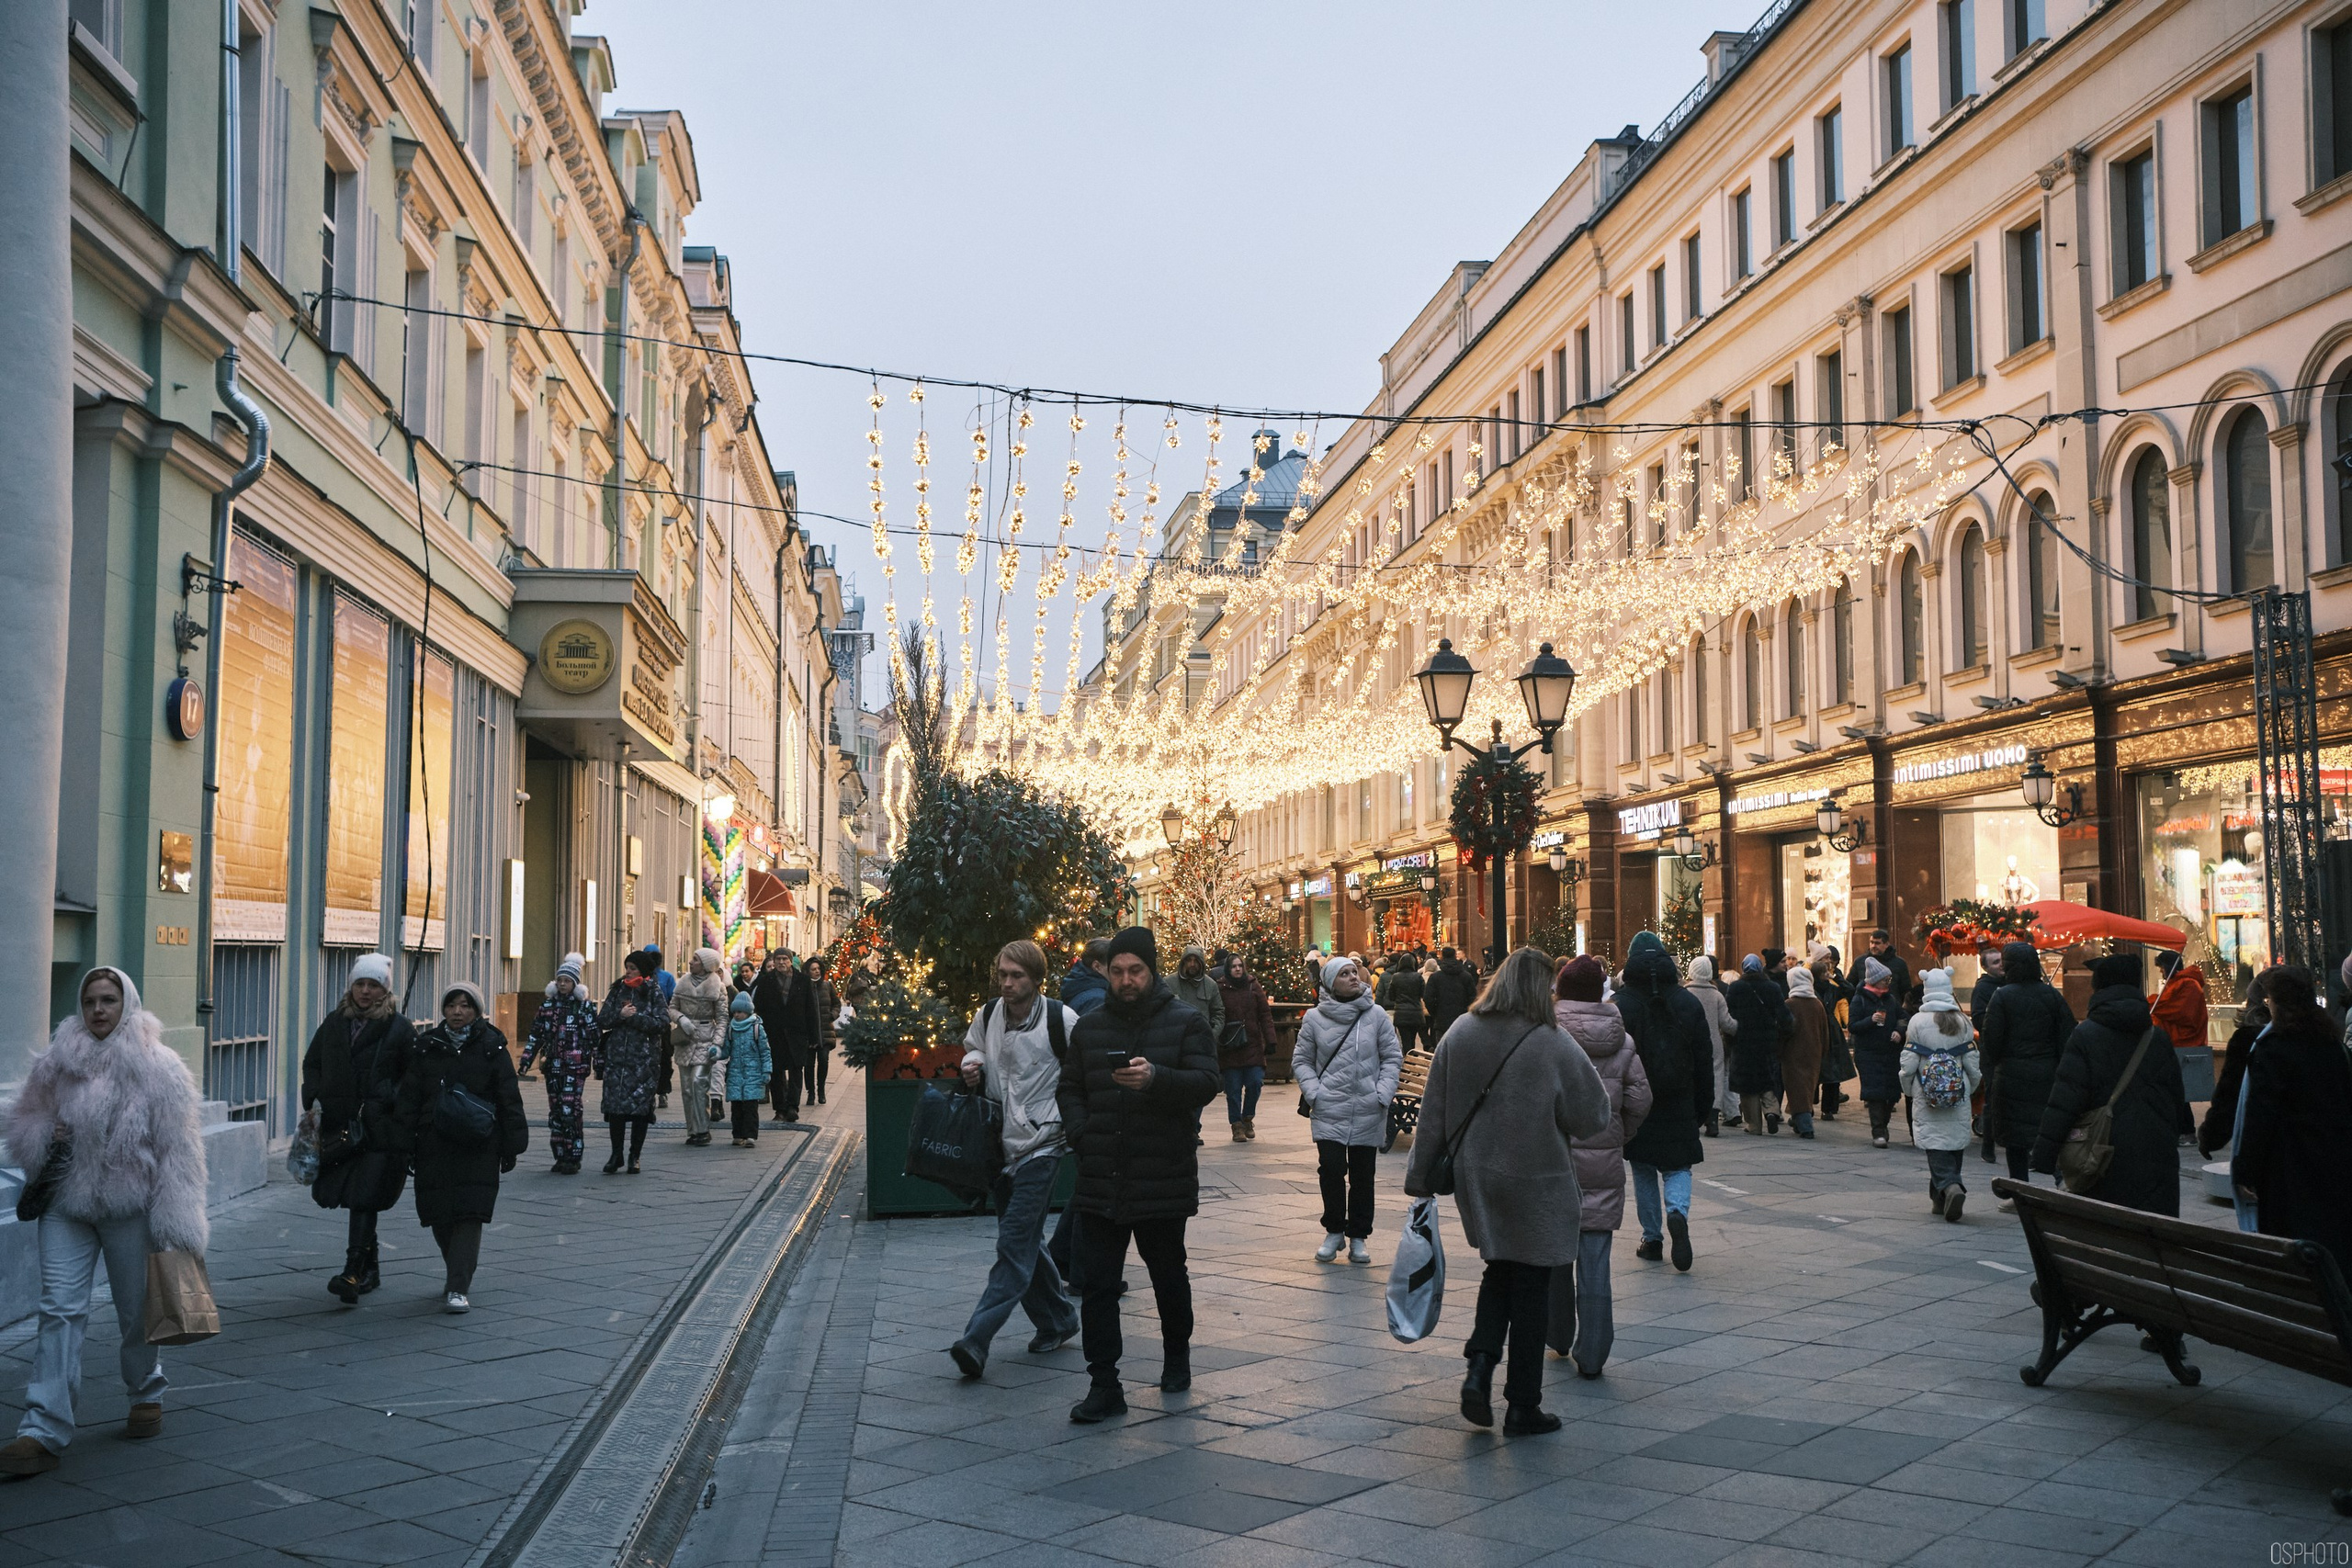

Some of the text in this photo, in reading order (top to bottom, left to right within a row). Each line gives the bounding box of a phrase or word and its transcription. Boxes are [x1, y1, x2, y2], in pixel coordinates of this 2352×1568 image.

[249, 623, 291, 658] ВОЛШЕБНАЯ
[264, 653, 291, 680] ФЛЕЙТА
[556, 660, 597, 670] Большой
[564, 669, 589, 679] театр
[187, 691, 199, 723] 17
[1984, 744, 2027, 768] UOMO
[1618, 799, 1680, 835] TEHNIKUM
[922, 1137, 962, 1158] FABRIC
